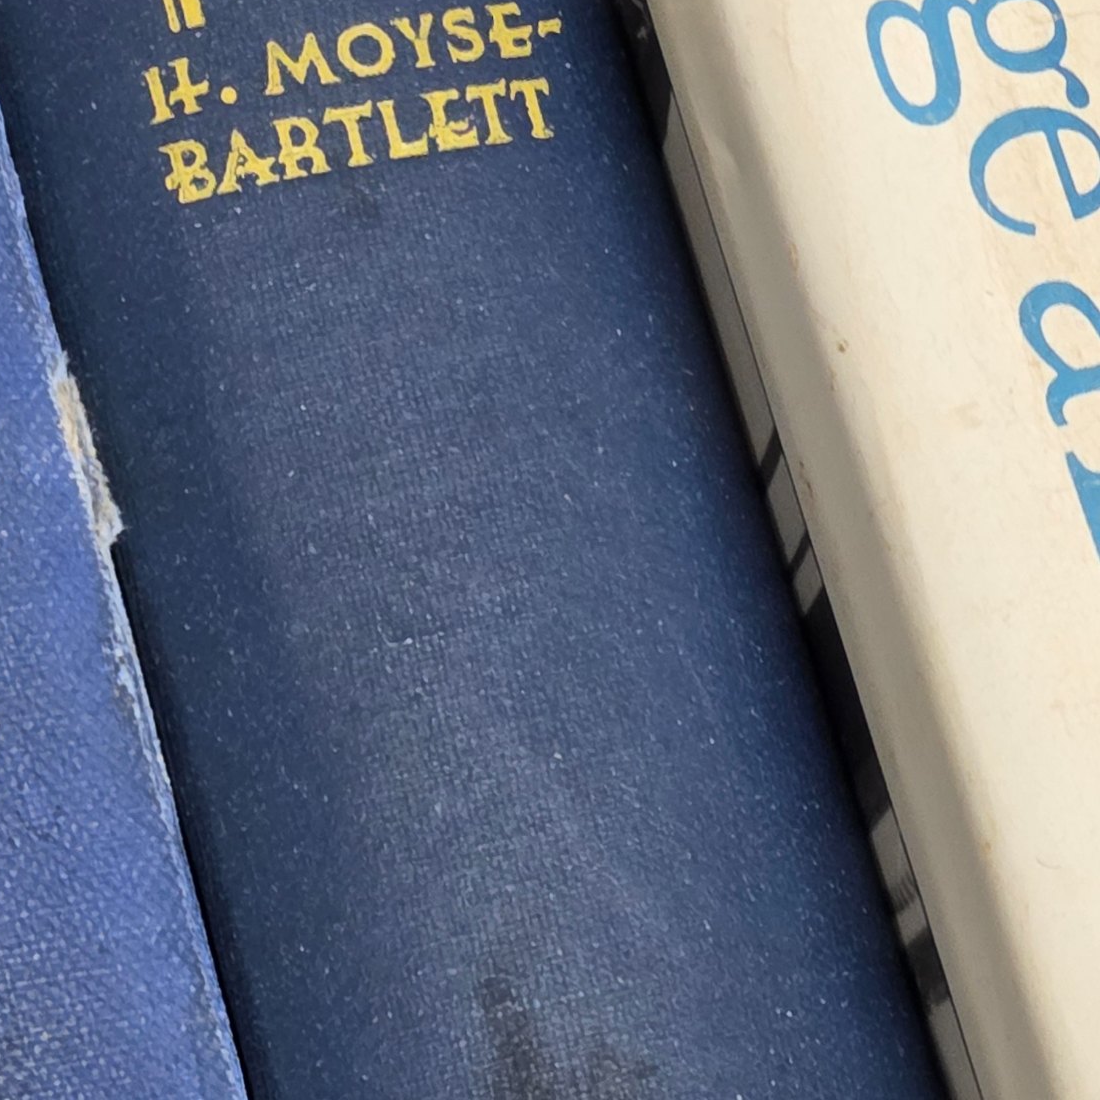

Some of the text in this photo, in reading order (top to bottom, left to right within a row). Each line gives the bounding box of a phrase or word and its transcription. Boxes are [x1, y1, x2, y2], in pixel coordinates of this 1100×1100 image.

[142, 1, 562, 124] H. MOYSE-
[159, 77, 555, 203] BARTLETT
